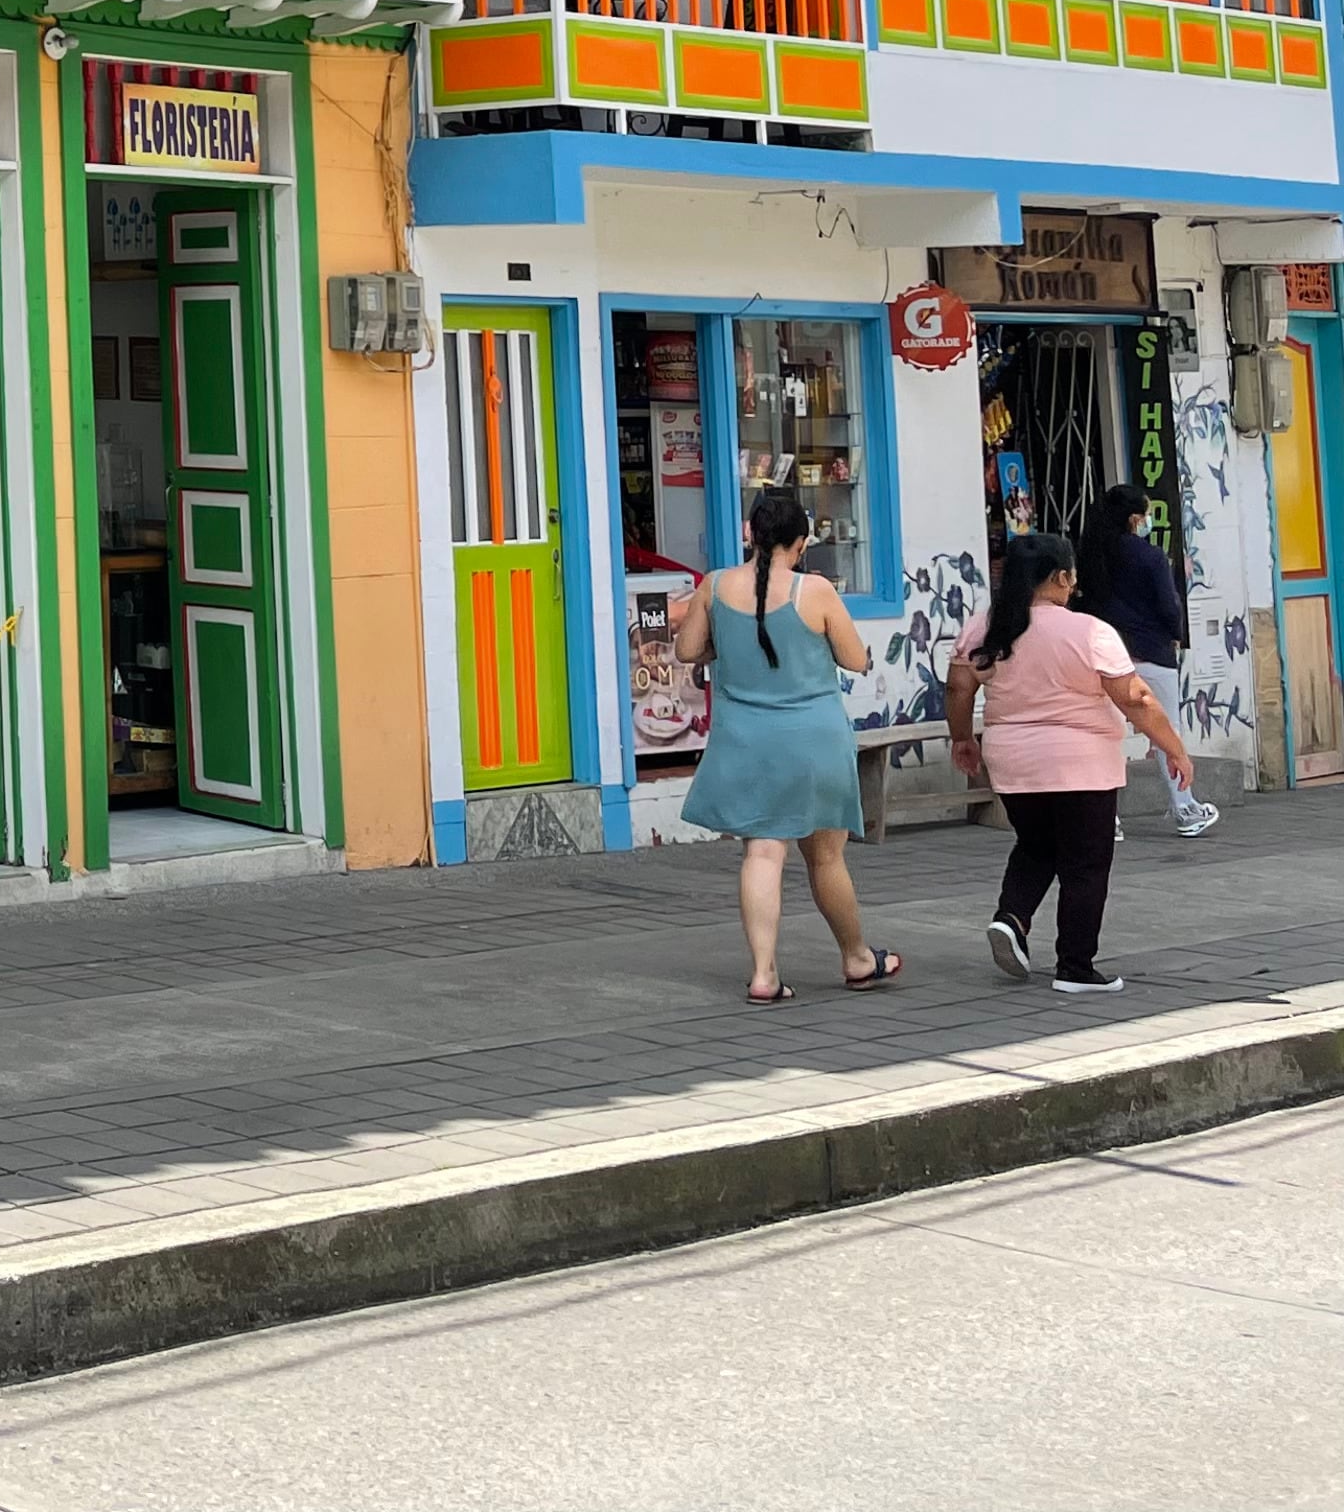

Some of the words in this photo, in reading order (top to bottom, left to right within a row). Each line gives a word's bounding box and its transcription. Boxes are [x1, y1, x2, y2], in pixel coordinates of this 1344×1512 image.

[128, 96, 256, 163] FLORISTERÍA
[901, 338, 960, 348] GATORADE
[1139, 402, 1164, 487] HAY
[1149, 500, 1172, 556] QU
[640, 609, 666, 628] Polet
[635, 665, 693, 690] OMA
